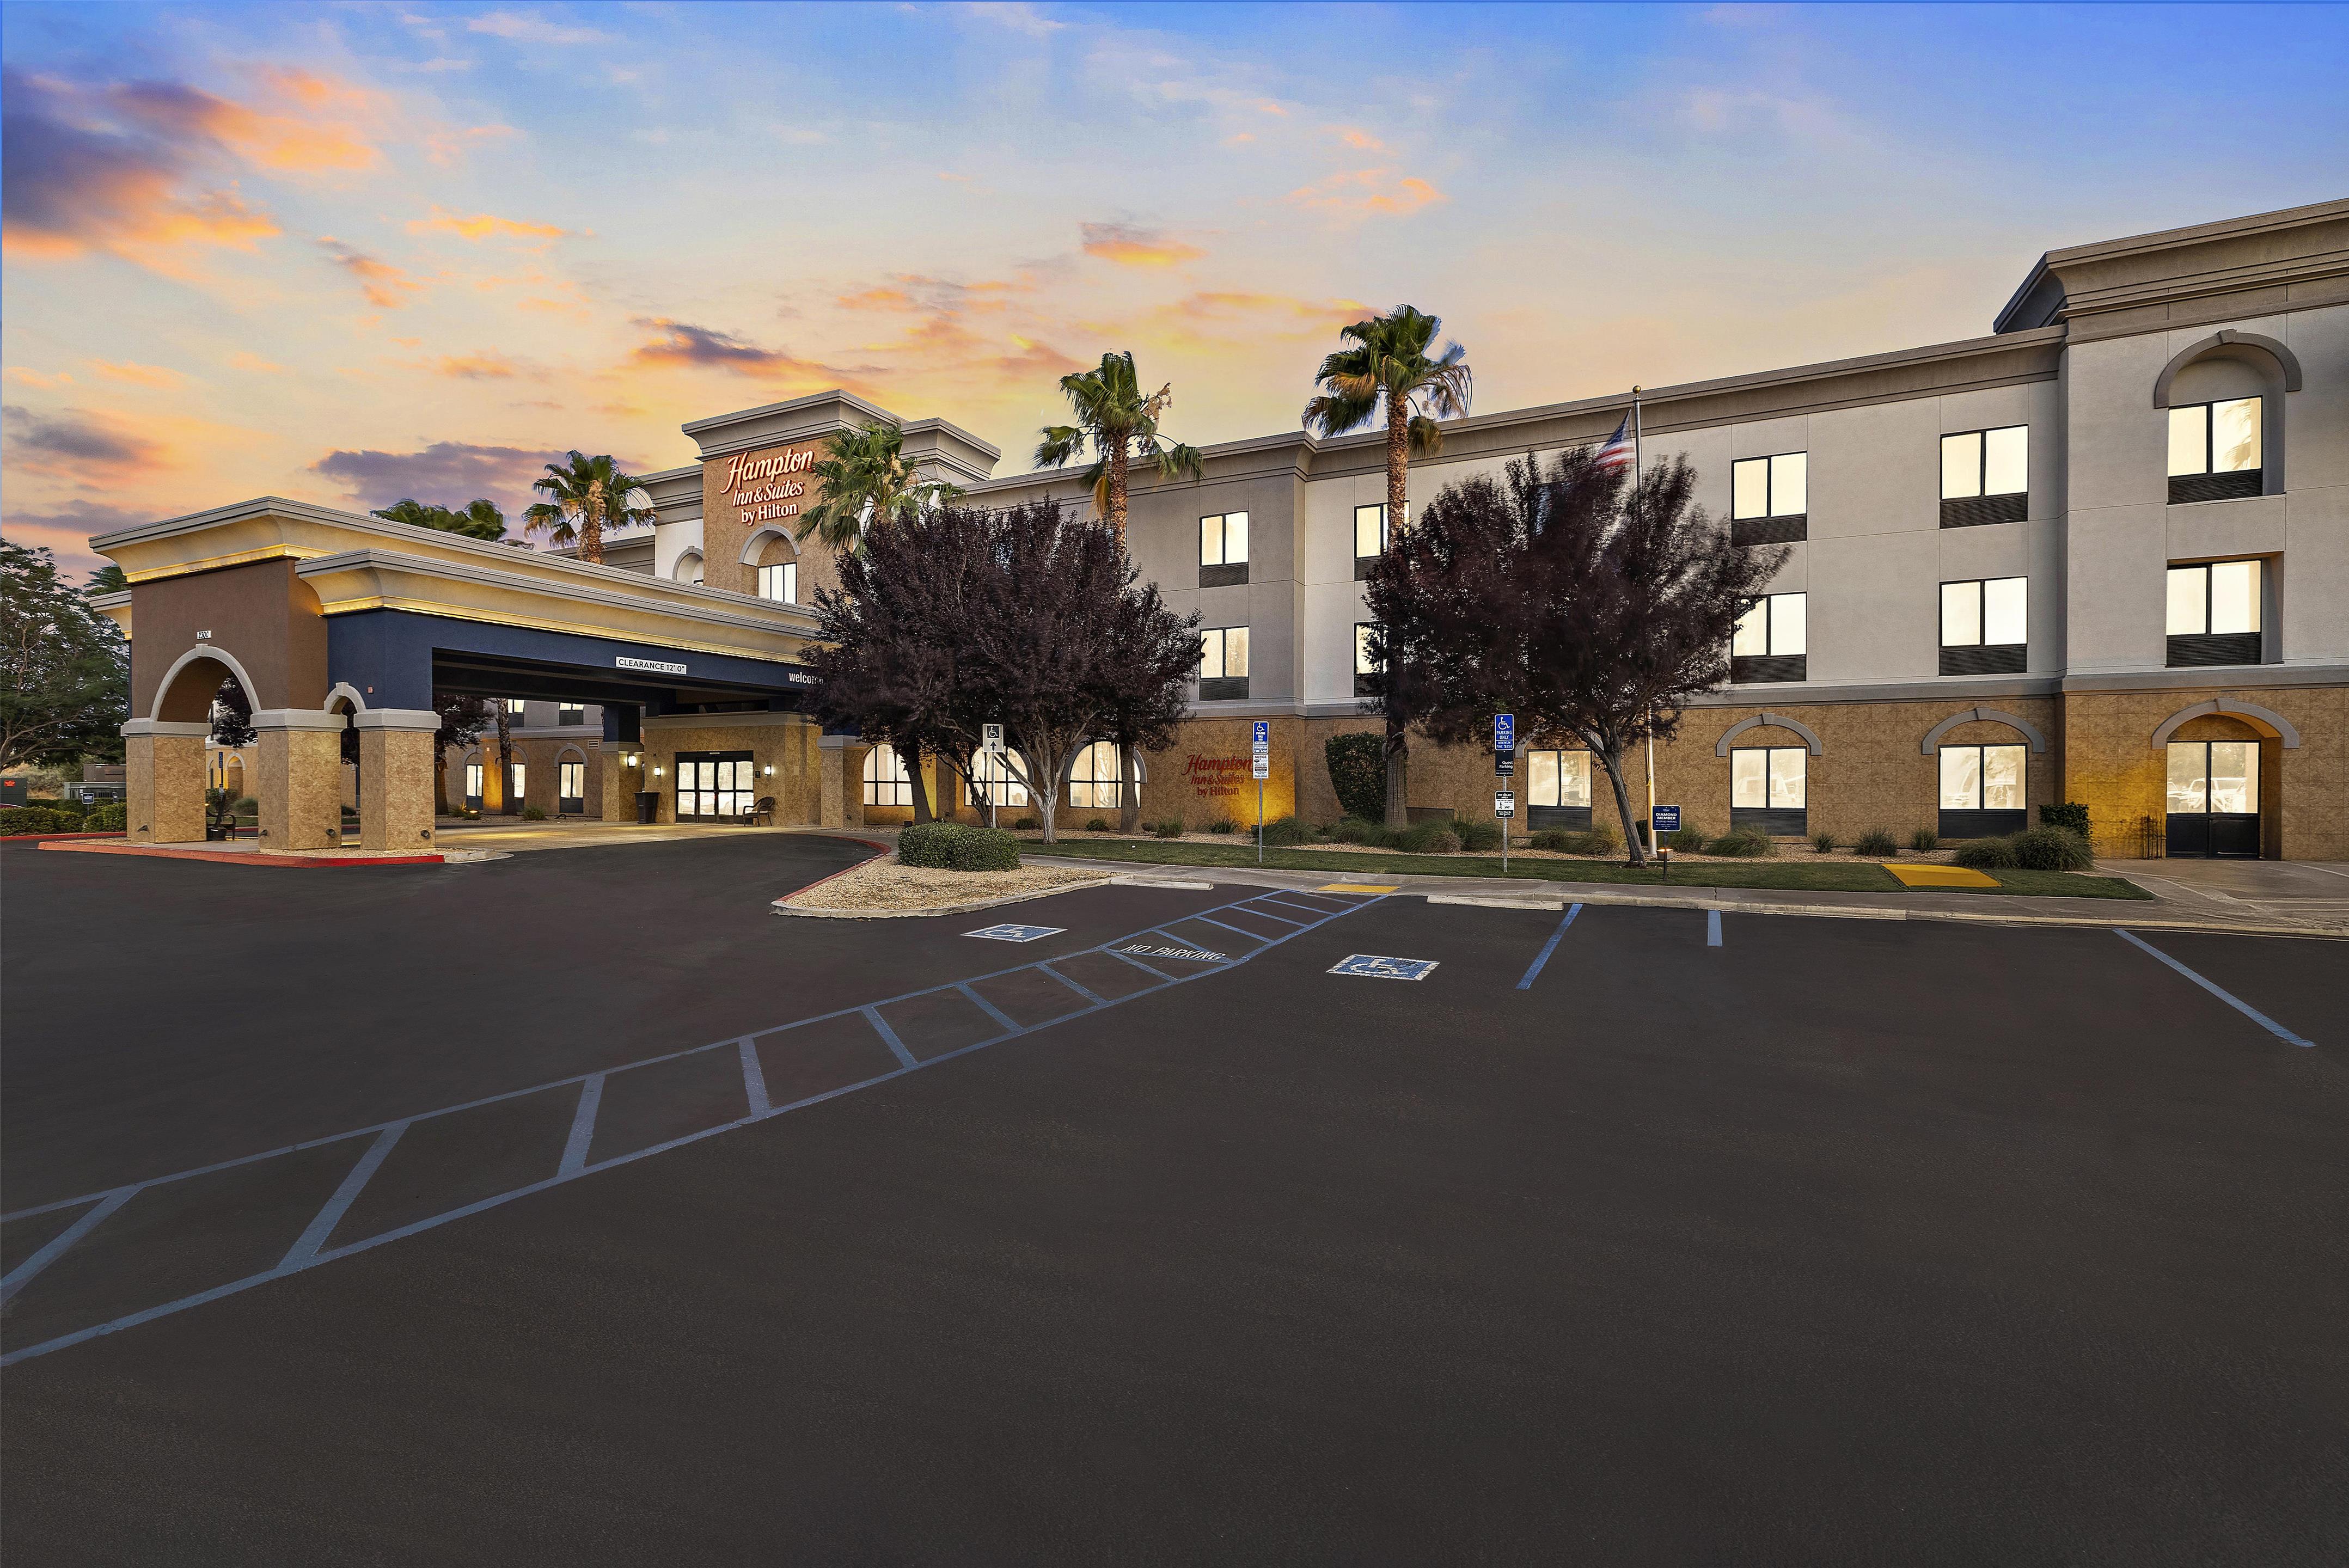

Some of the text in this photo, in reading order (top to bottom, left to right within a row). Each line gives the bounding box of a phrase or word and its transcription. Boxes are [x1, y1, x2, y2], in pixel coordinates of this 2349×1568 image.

[720, 448, 815, 494] Hampton
[741, 504, 799, 526] by Hilton
[619, 659, 664, 670] CLEARANCE
[1180, 752, 1253, 776] Hampton
[1197, 787, 1240, 798] by Hilton
[1121, 944, 1226, 960] NO PARKING
